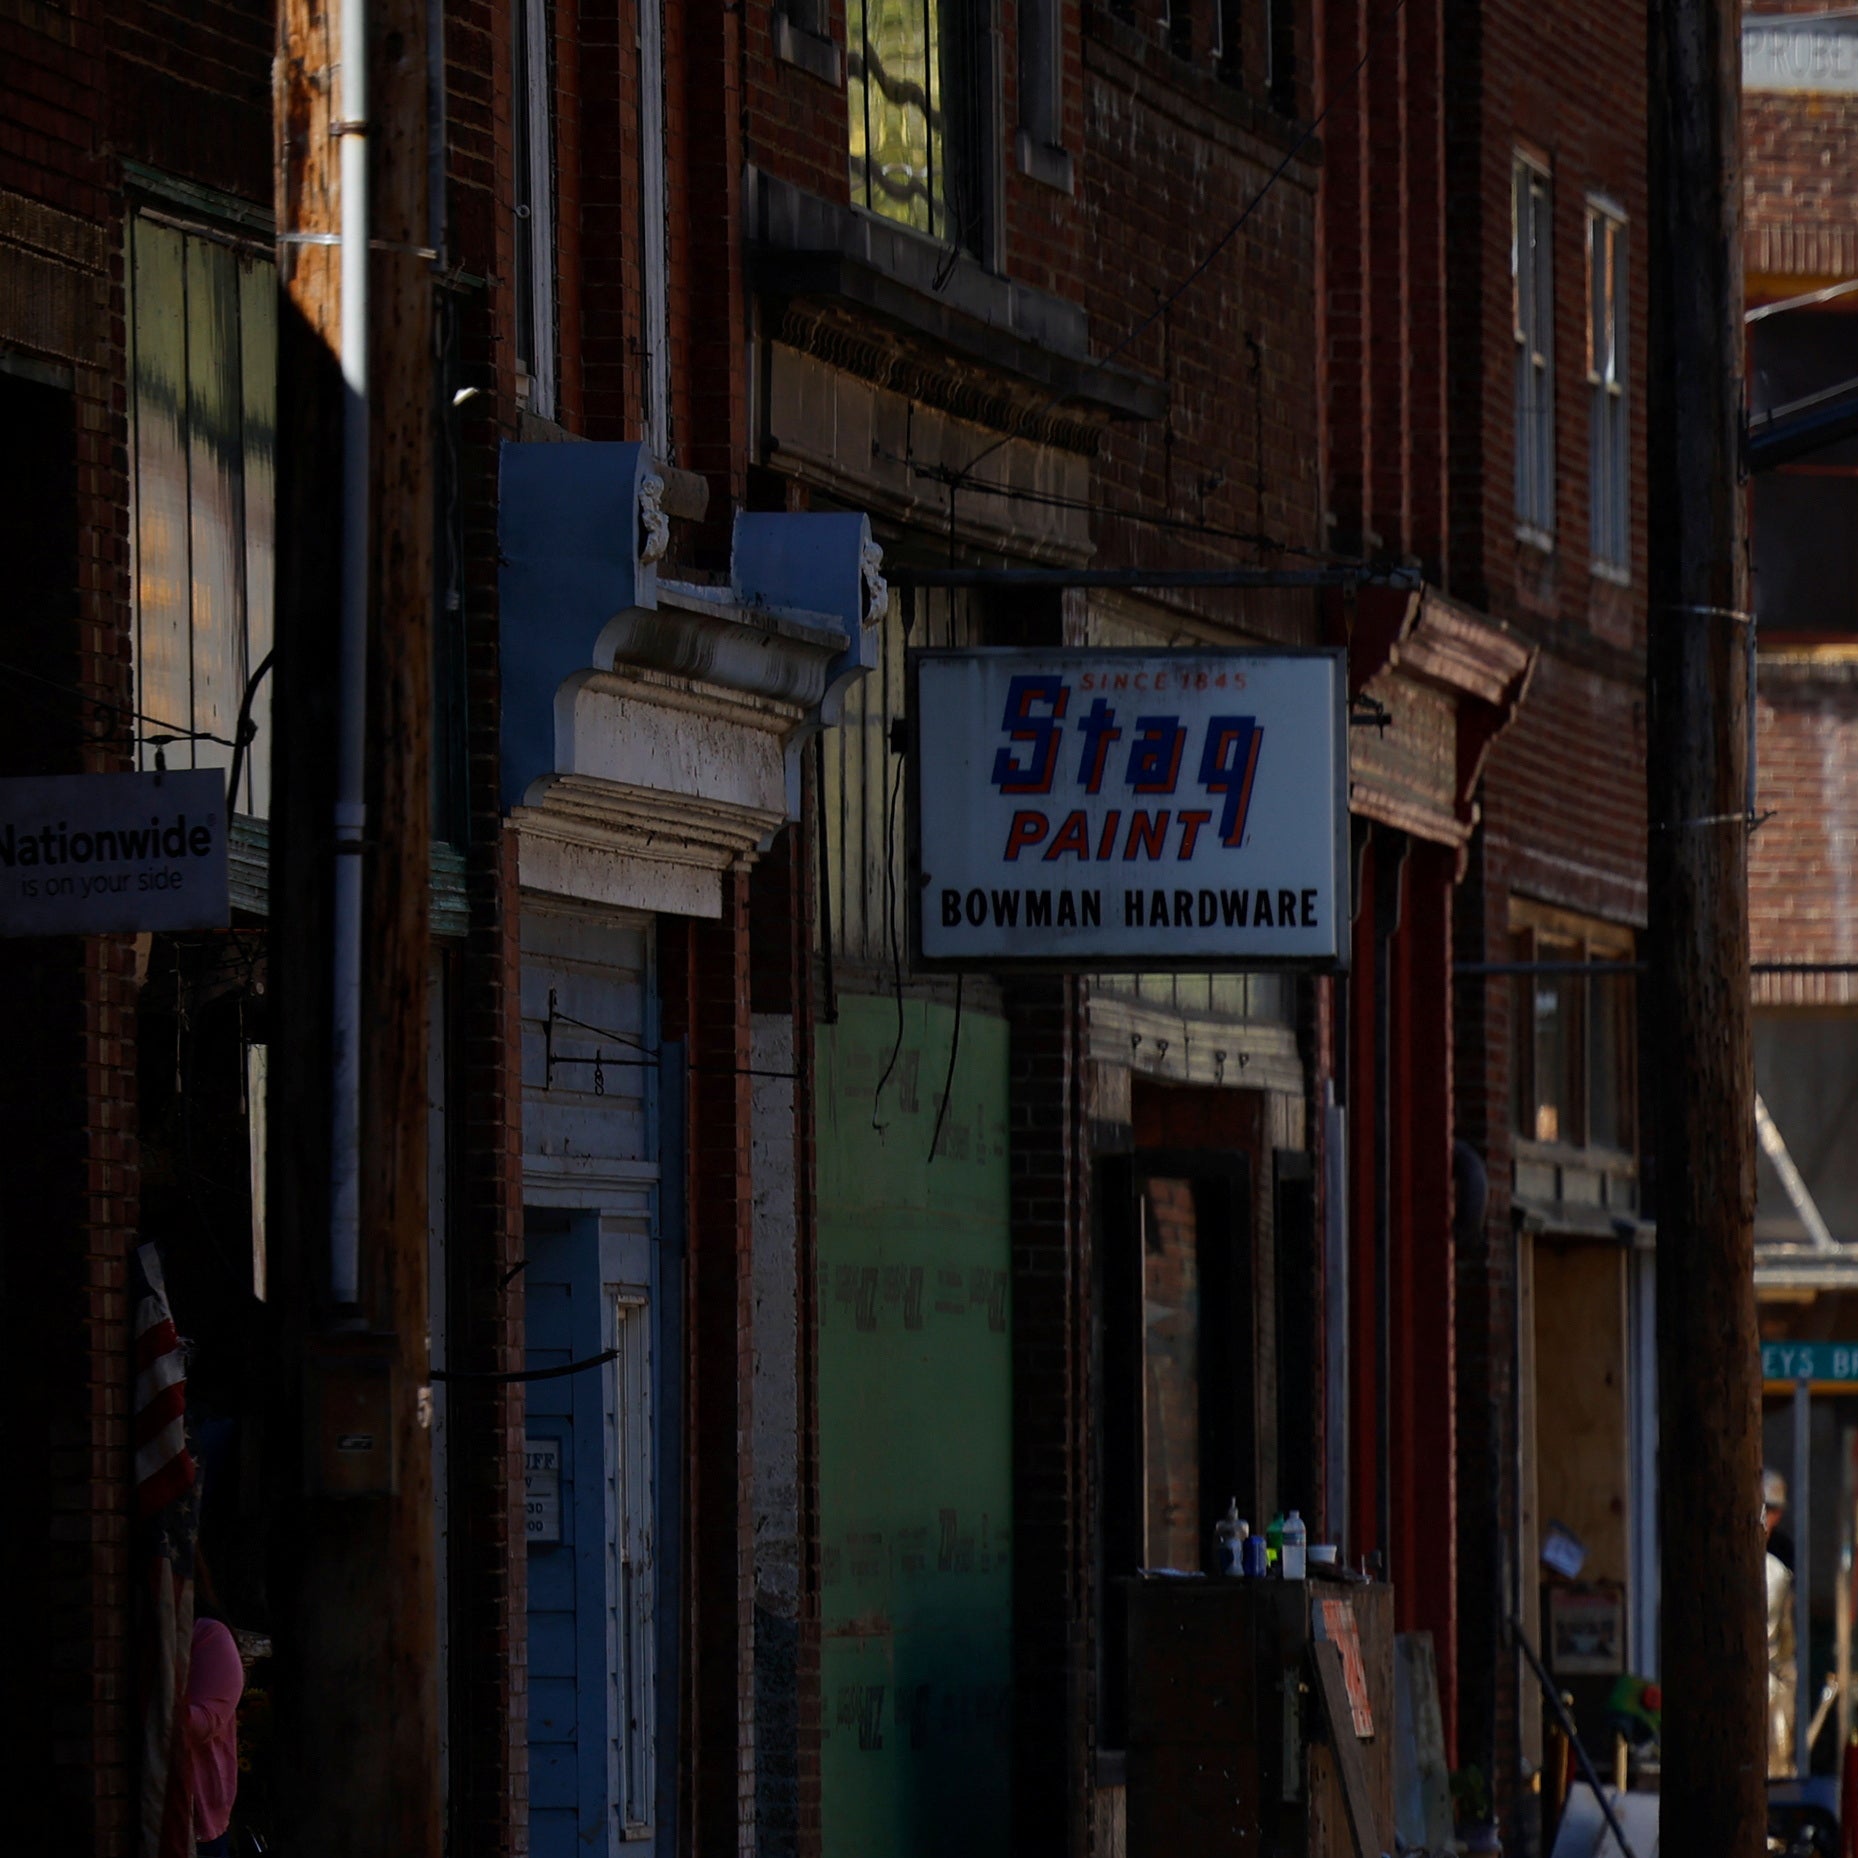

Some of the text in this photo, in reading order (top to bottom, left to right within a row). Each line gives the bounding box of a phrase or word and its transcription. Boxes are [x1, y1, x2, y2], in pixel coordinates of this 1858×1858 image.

[1080, 672, 1249, 691] SINCE 1845
[991, 675, 1264, 848] Stag
[0, 814, 212, 867] Nationwide
[1003, 809, 1212, 861] PAINT
[22, 866, 183, 899] is on your side
[941, 888, 1319, 928] BOWMAN HARDWARE
